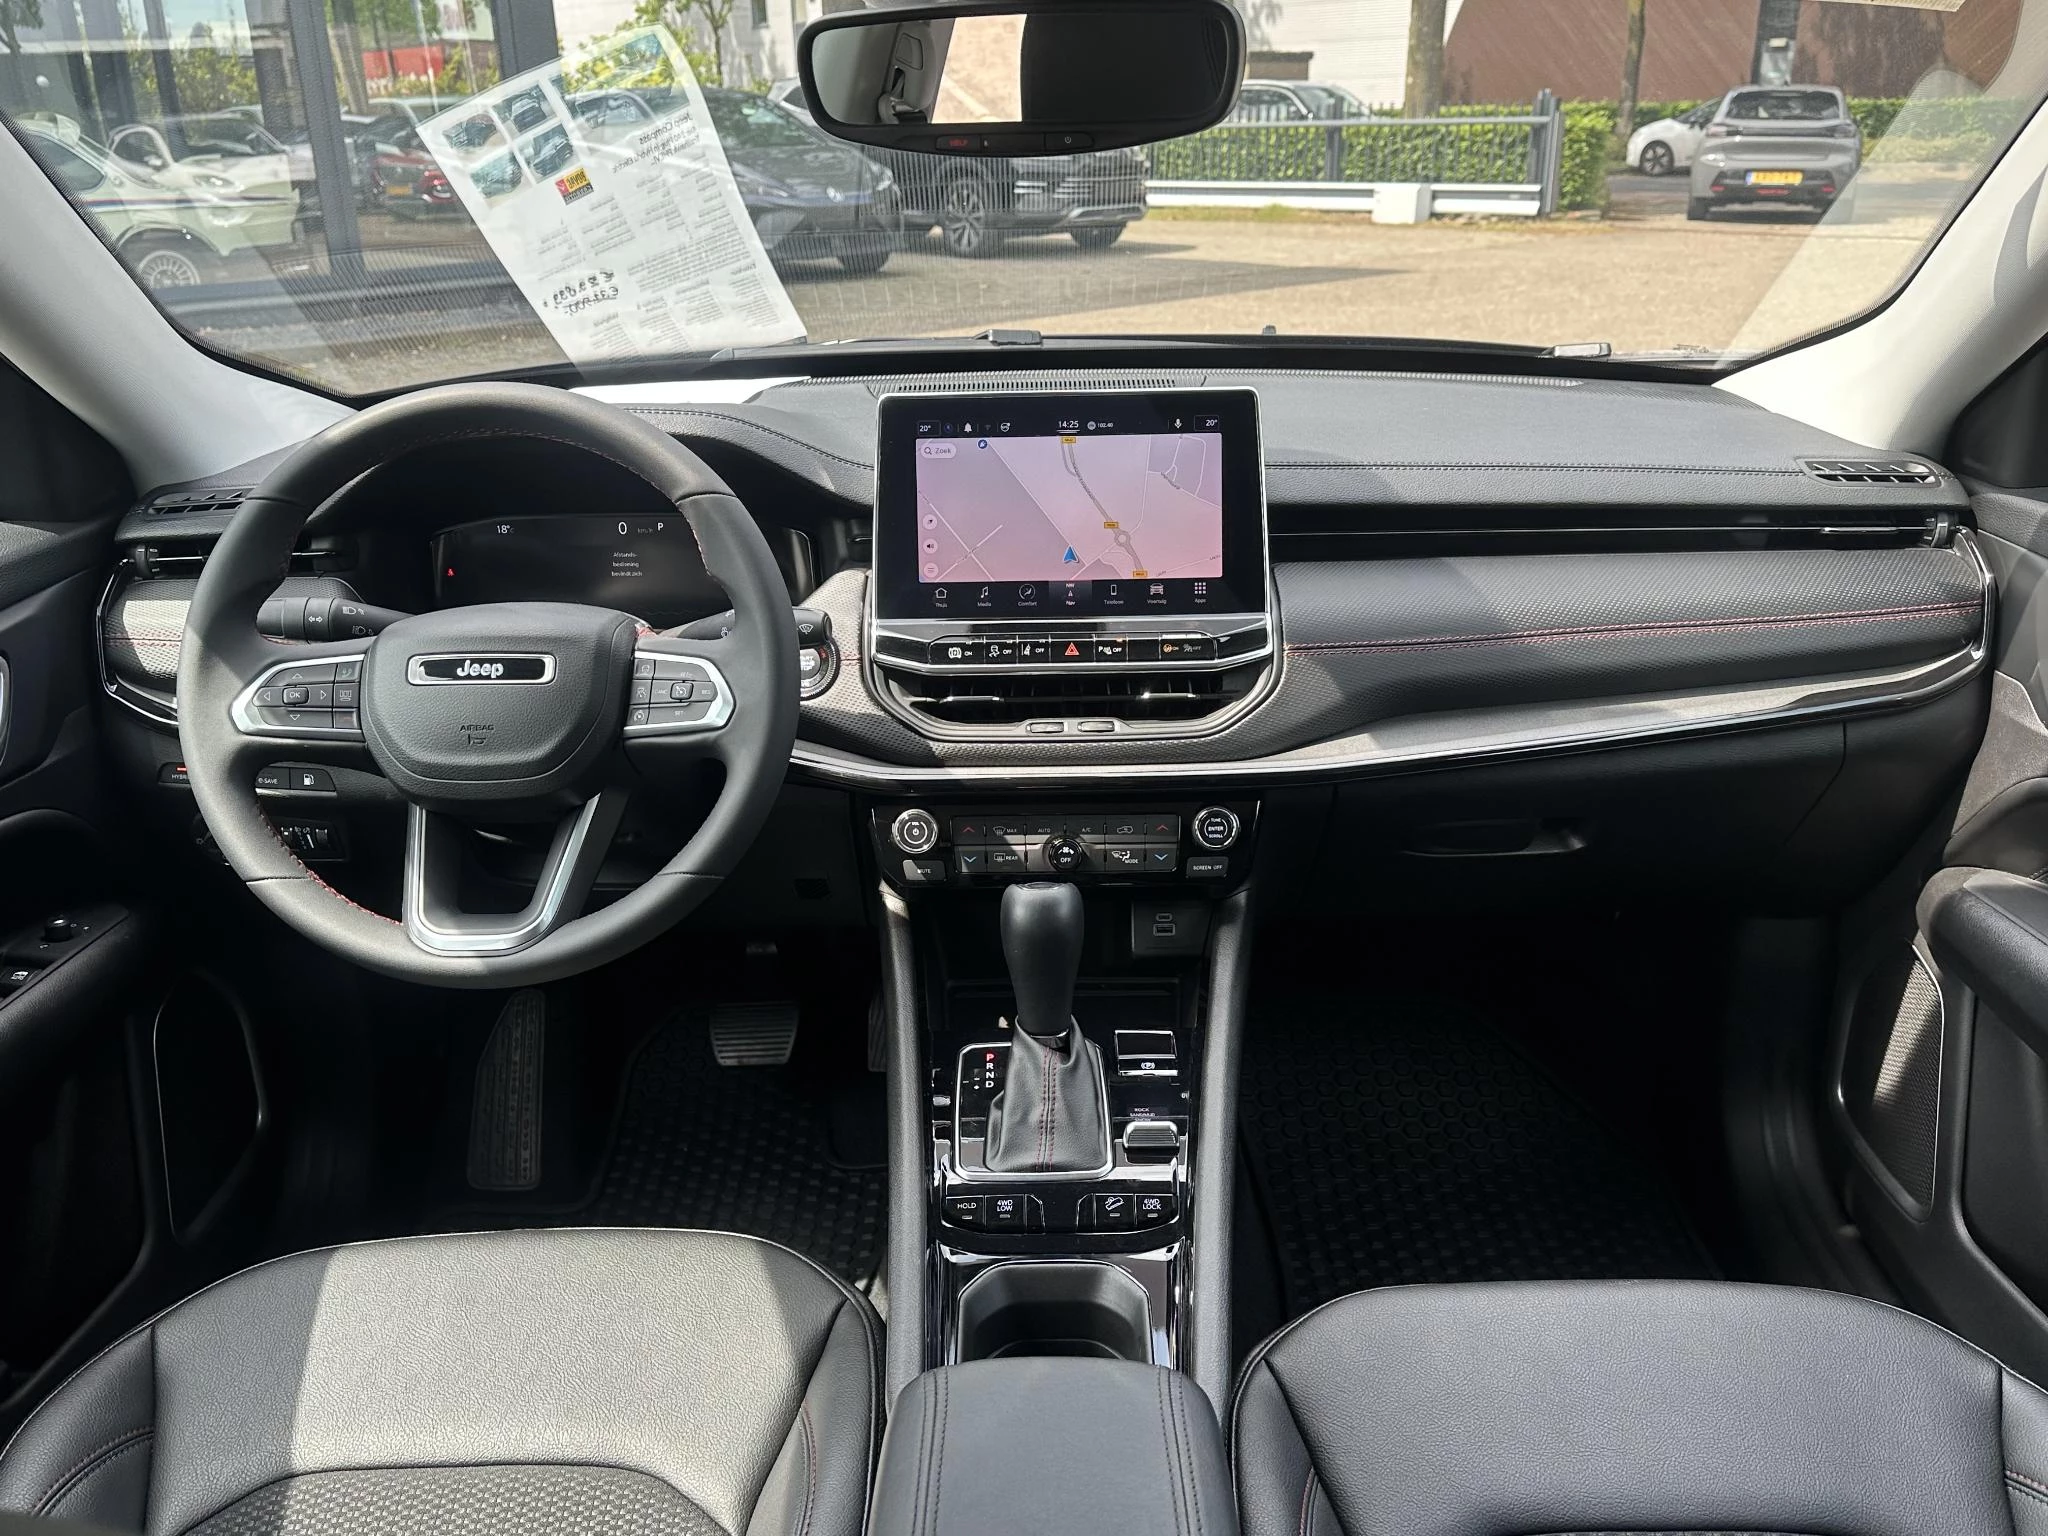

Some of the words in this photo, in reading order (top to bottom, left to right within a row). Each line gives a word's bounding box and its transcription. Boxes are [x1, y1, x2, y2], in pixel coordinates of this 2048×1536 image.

[1058, 420, 1079, 429] 14:25
[935, 446, 952, 454] Zoek
[618, 521, 628, 535] 0
[656, 522, 664, 532] P
[456, 659, 504, 679] Jeep
[289, 691, 301, 699] OK
[459, 724, 495, 732] AIRBAG
[986, 1053, 995, 1062] P
[986, 1062, 994, 1070] R
[985, 1071, 995, 1079] N
[985, 1080, 995, 1088] D
[957, 1202, 977, 1210] HOLD
[1142, 1203, 1162, 1211] LOCK
